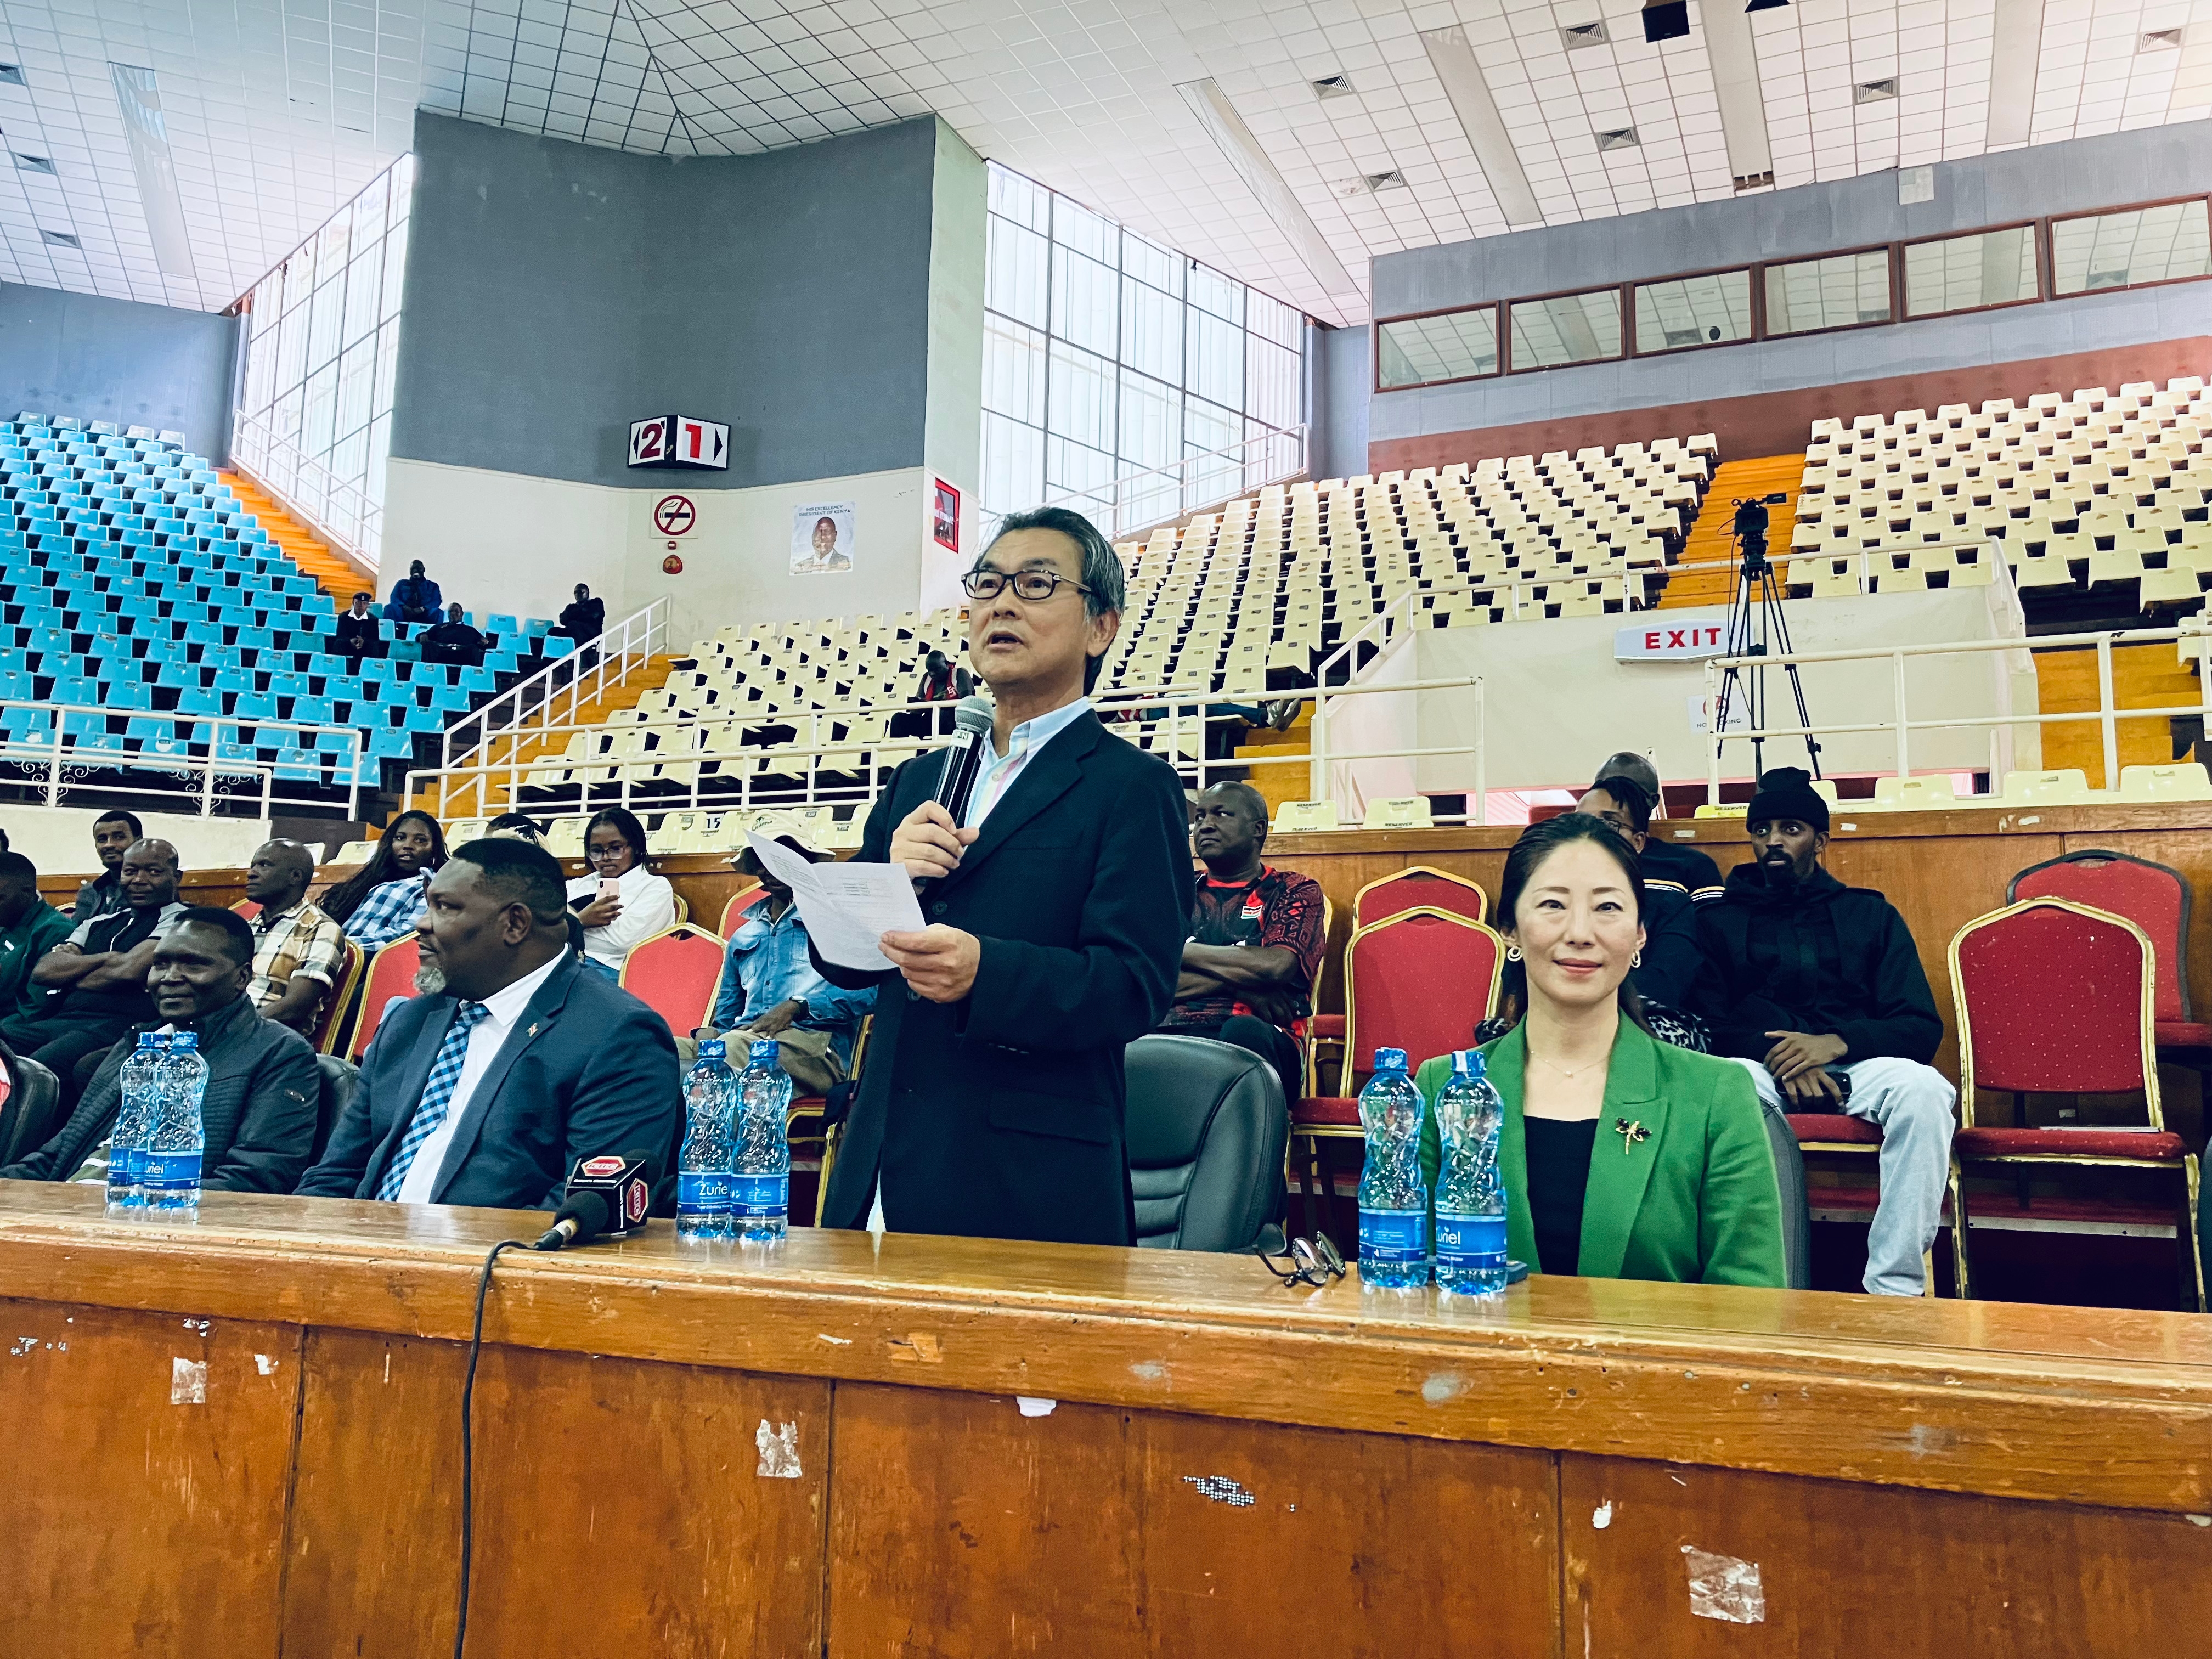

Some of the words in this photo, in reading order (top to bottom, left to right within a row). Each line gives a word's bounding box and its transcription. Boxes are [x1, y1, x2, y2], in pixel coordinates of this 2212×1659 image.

[640, 423, 662, 459] 2
[685, 423, 702, 459] 1
[1646, 628, 1721, 649] EXIT
[707, 817, 721, 829] 15
